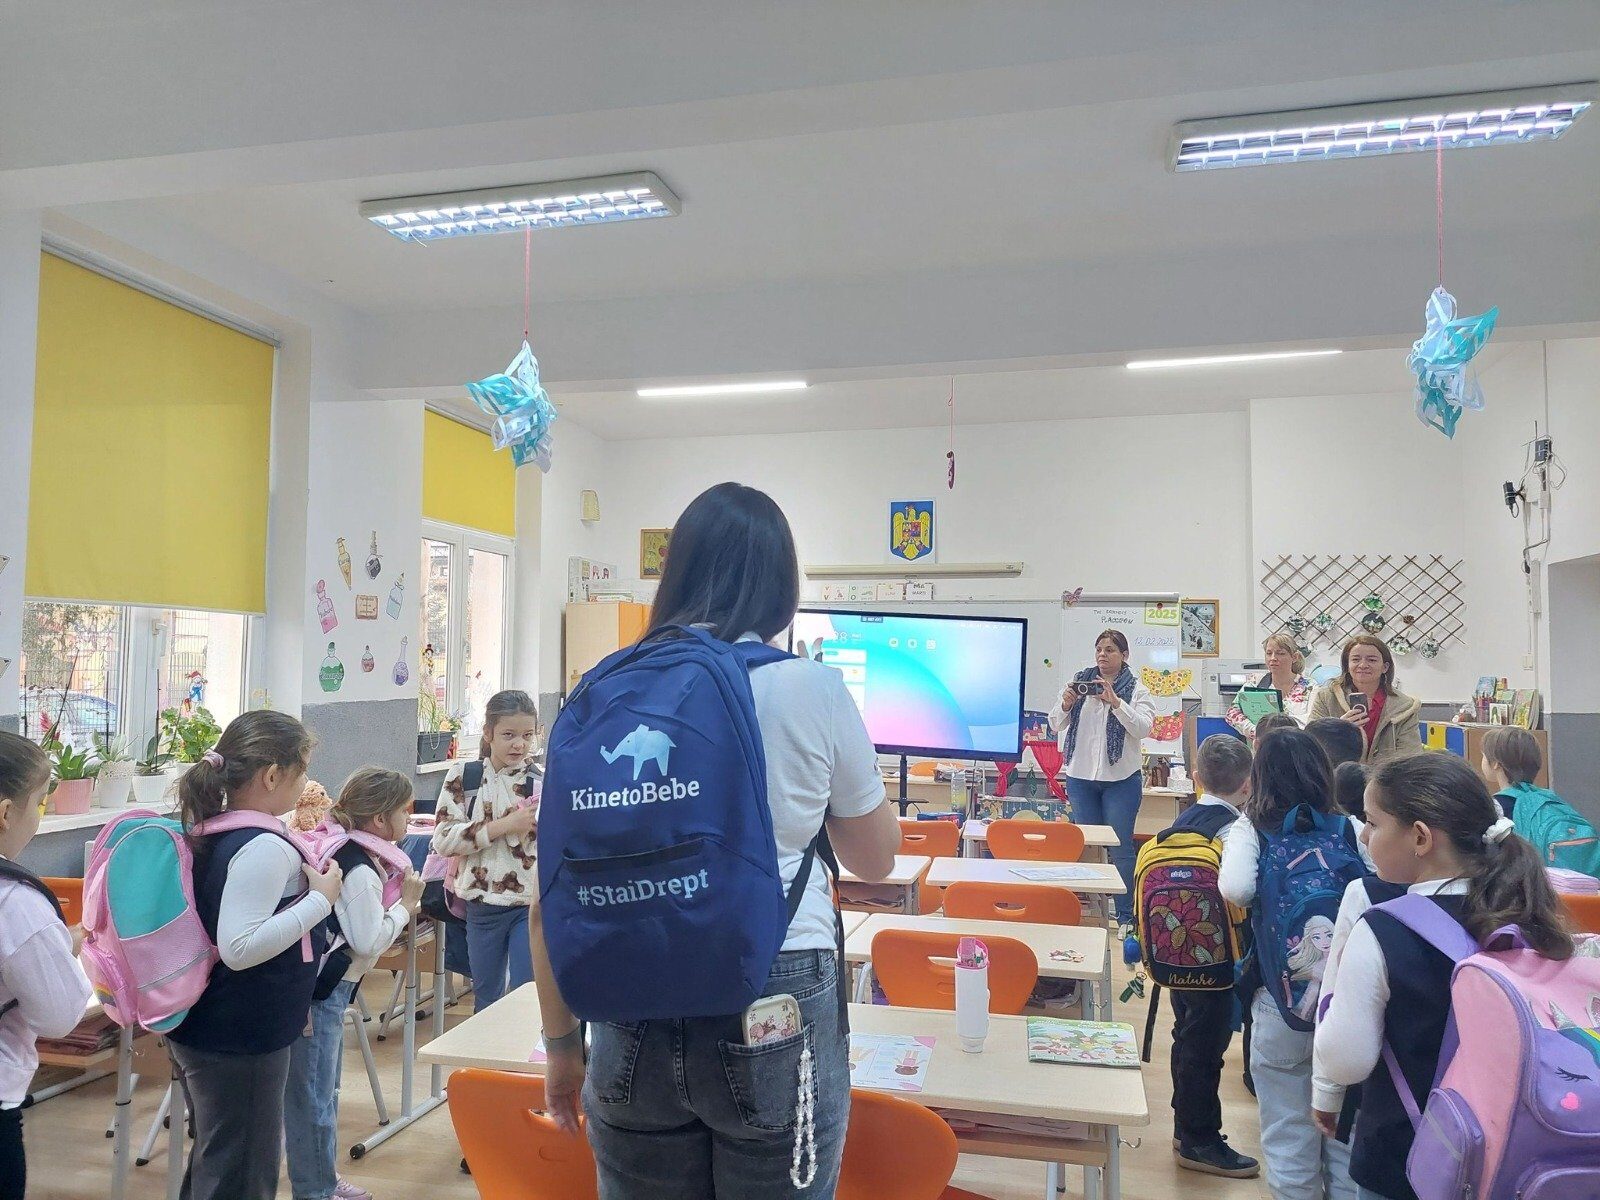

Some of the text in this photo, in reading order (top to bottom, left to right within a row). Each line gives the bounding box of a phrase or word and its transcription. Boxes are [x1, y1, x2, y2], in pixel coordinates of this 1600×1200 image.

[1148, 608, 1178, 619] 2025
[571, 778, 700, 811] KinetoBebe
[577, 868, 709, 907] #StaiDrept
[1168, 971, 1217, 986] Nature
